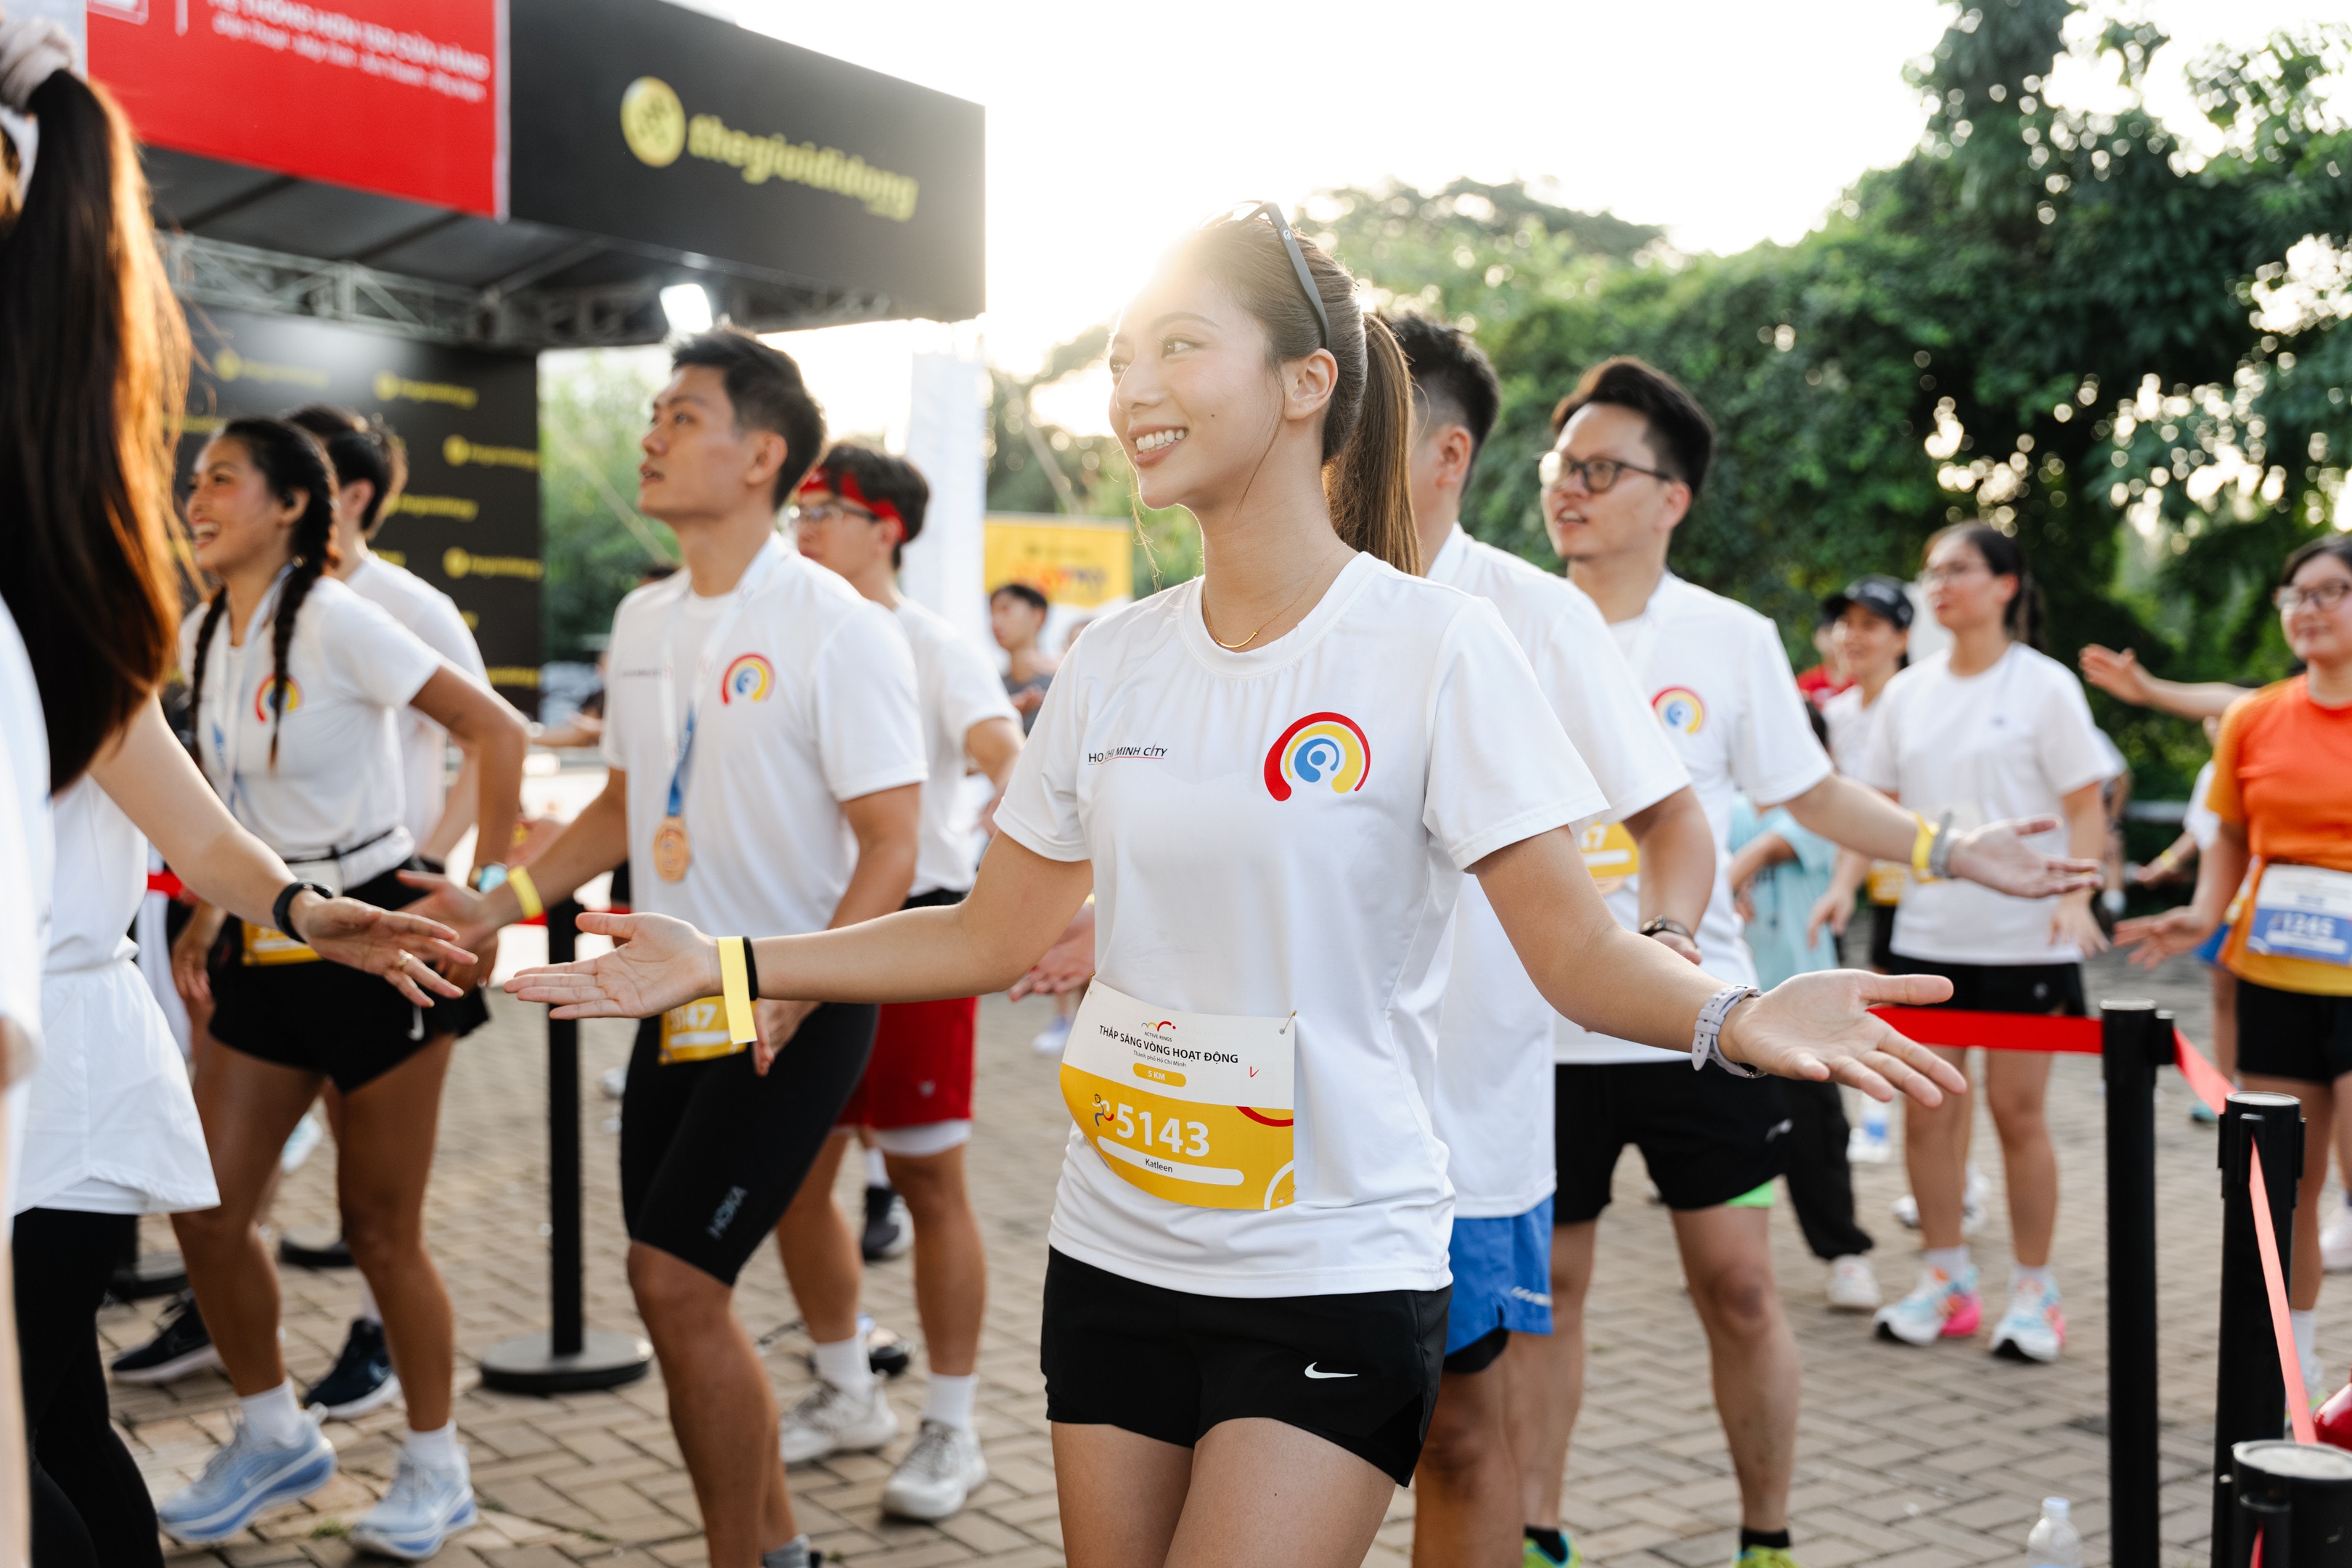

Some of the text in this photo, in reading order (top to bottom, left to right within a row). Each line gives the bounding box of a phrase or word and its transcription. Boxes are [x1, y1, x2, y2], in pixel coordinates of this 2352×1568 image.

[1088, 752, 1104, 762] HO
[1115, 746, 1141, 756] MINH
[1143, 741, 1168, 757] CITY
[1144, 1031, 1159, 1040] ACTIVE
[1099, 1024, 1238, 1065] THẮP SÁNG VÒNG HOẠT ĐỘNG
[1133, 1050, 1147, 1058] Thành
[1153, 1071, 1166, 1081] KM
[1116, 1102, 1210, 1158] 5143
[1145, 1158, 1173, 1173] Katleen
